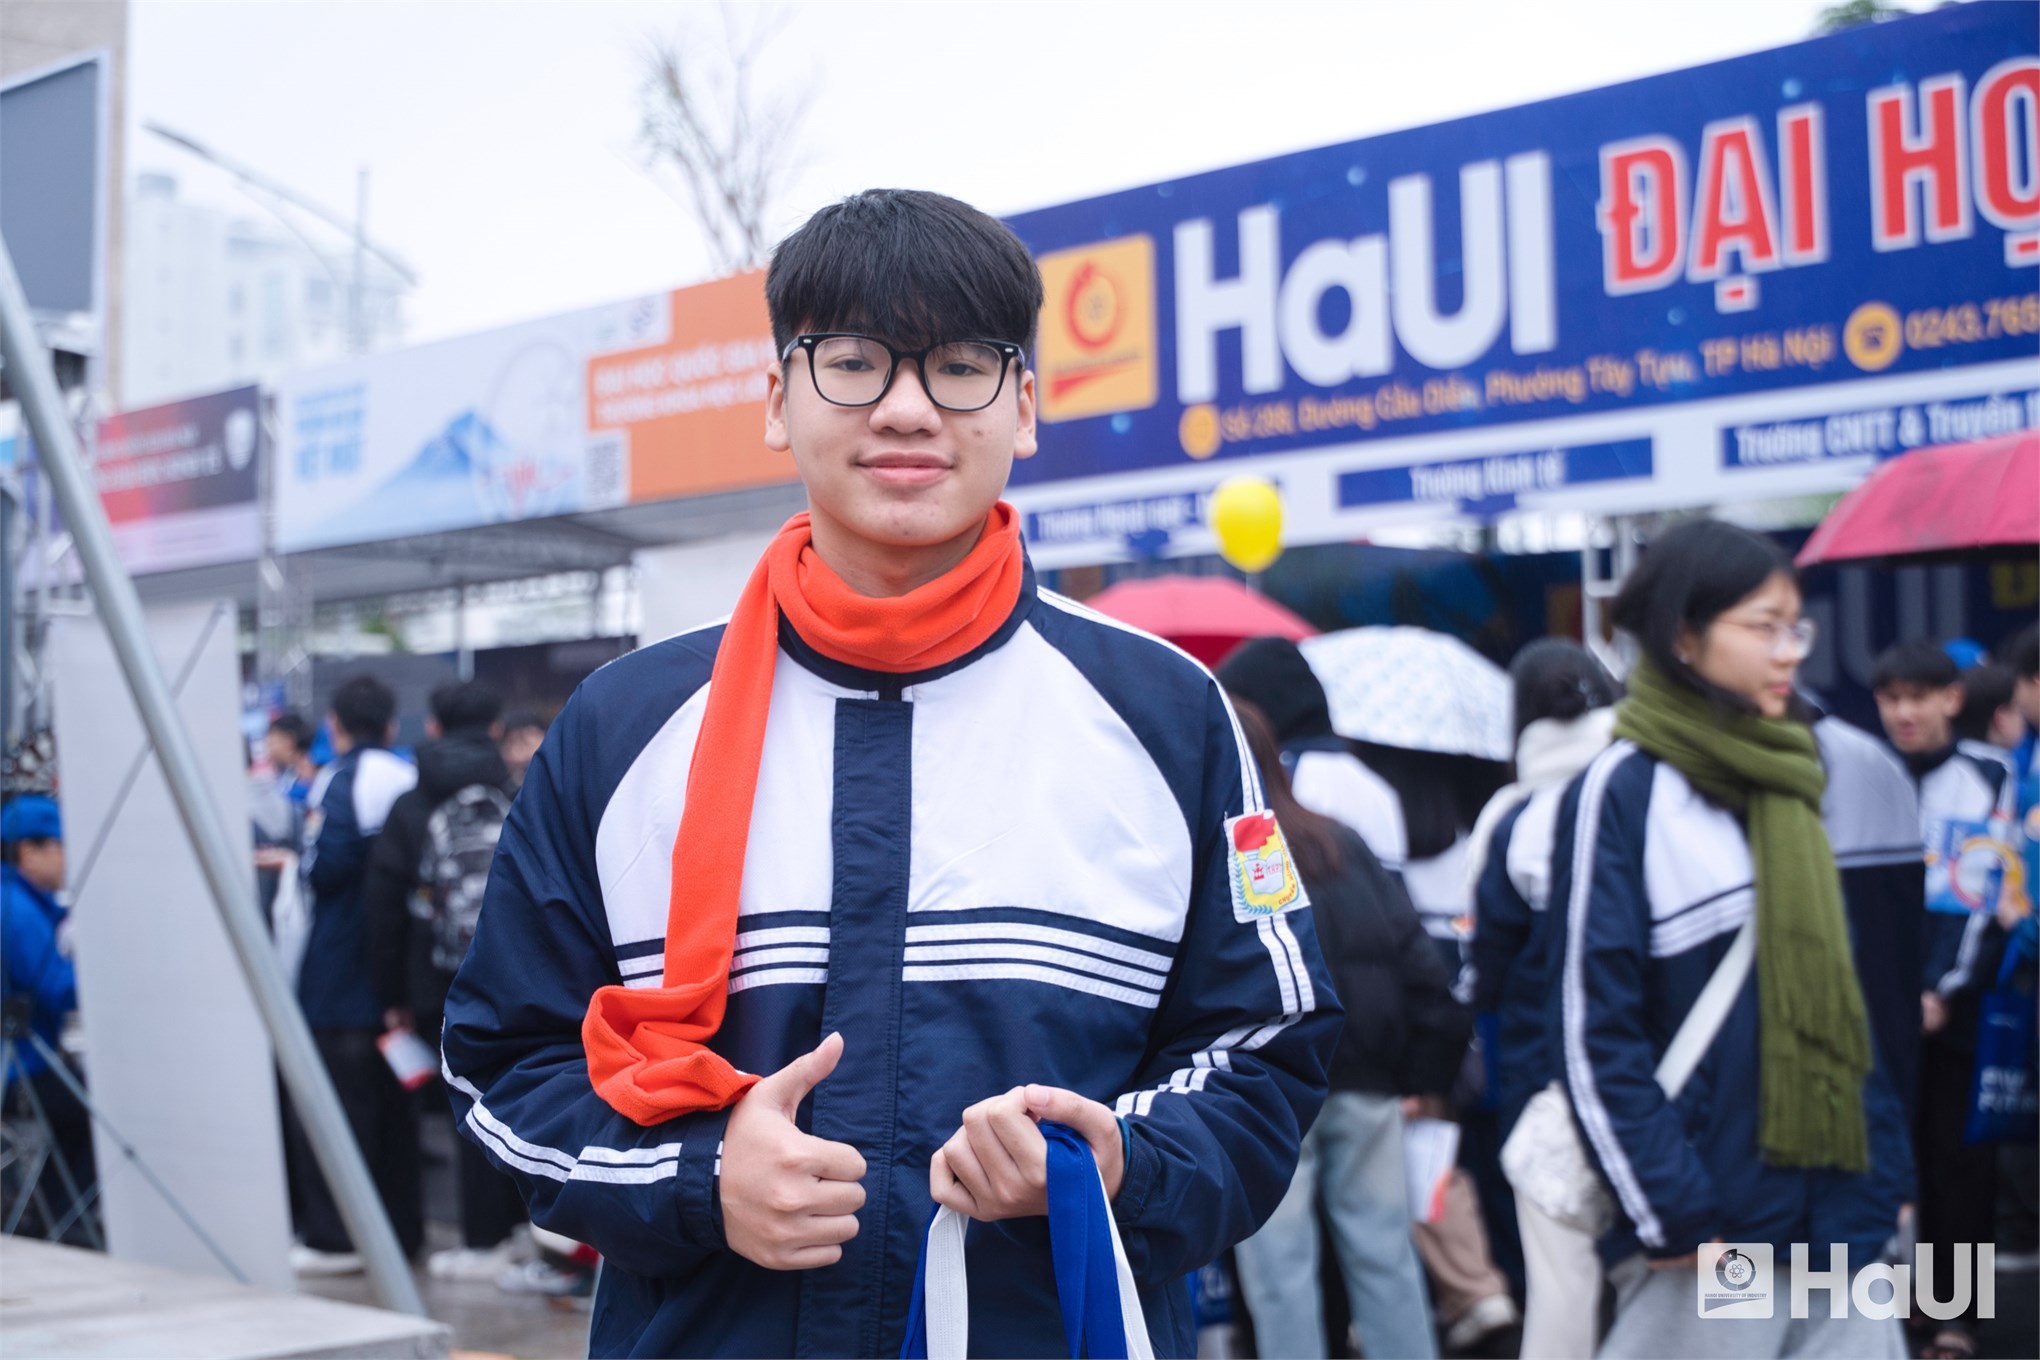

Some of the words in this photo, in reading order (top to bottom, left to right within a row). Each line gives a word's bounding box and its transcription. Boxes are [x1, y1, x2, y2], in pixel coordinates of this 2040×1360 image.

[1174, 149, 1557, 404] HaUI
[1597, 102, 1829, 313] ĐẠI
[1700, 335, 1739, 377] TP
[1897, 403, 1925, 449] &
